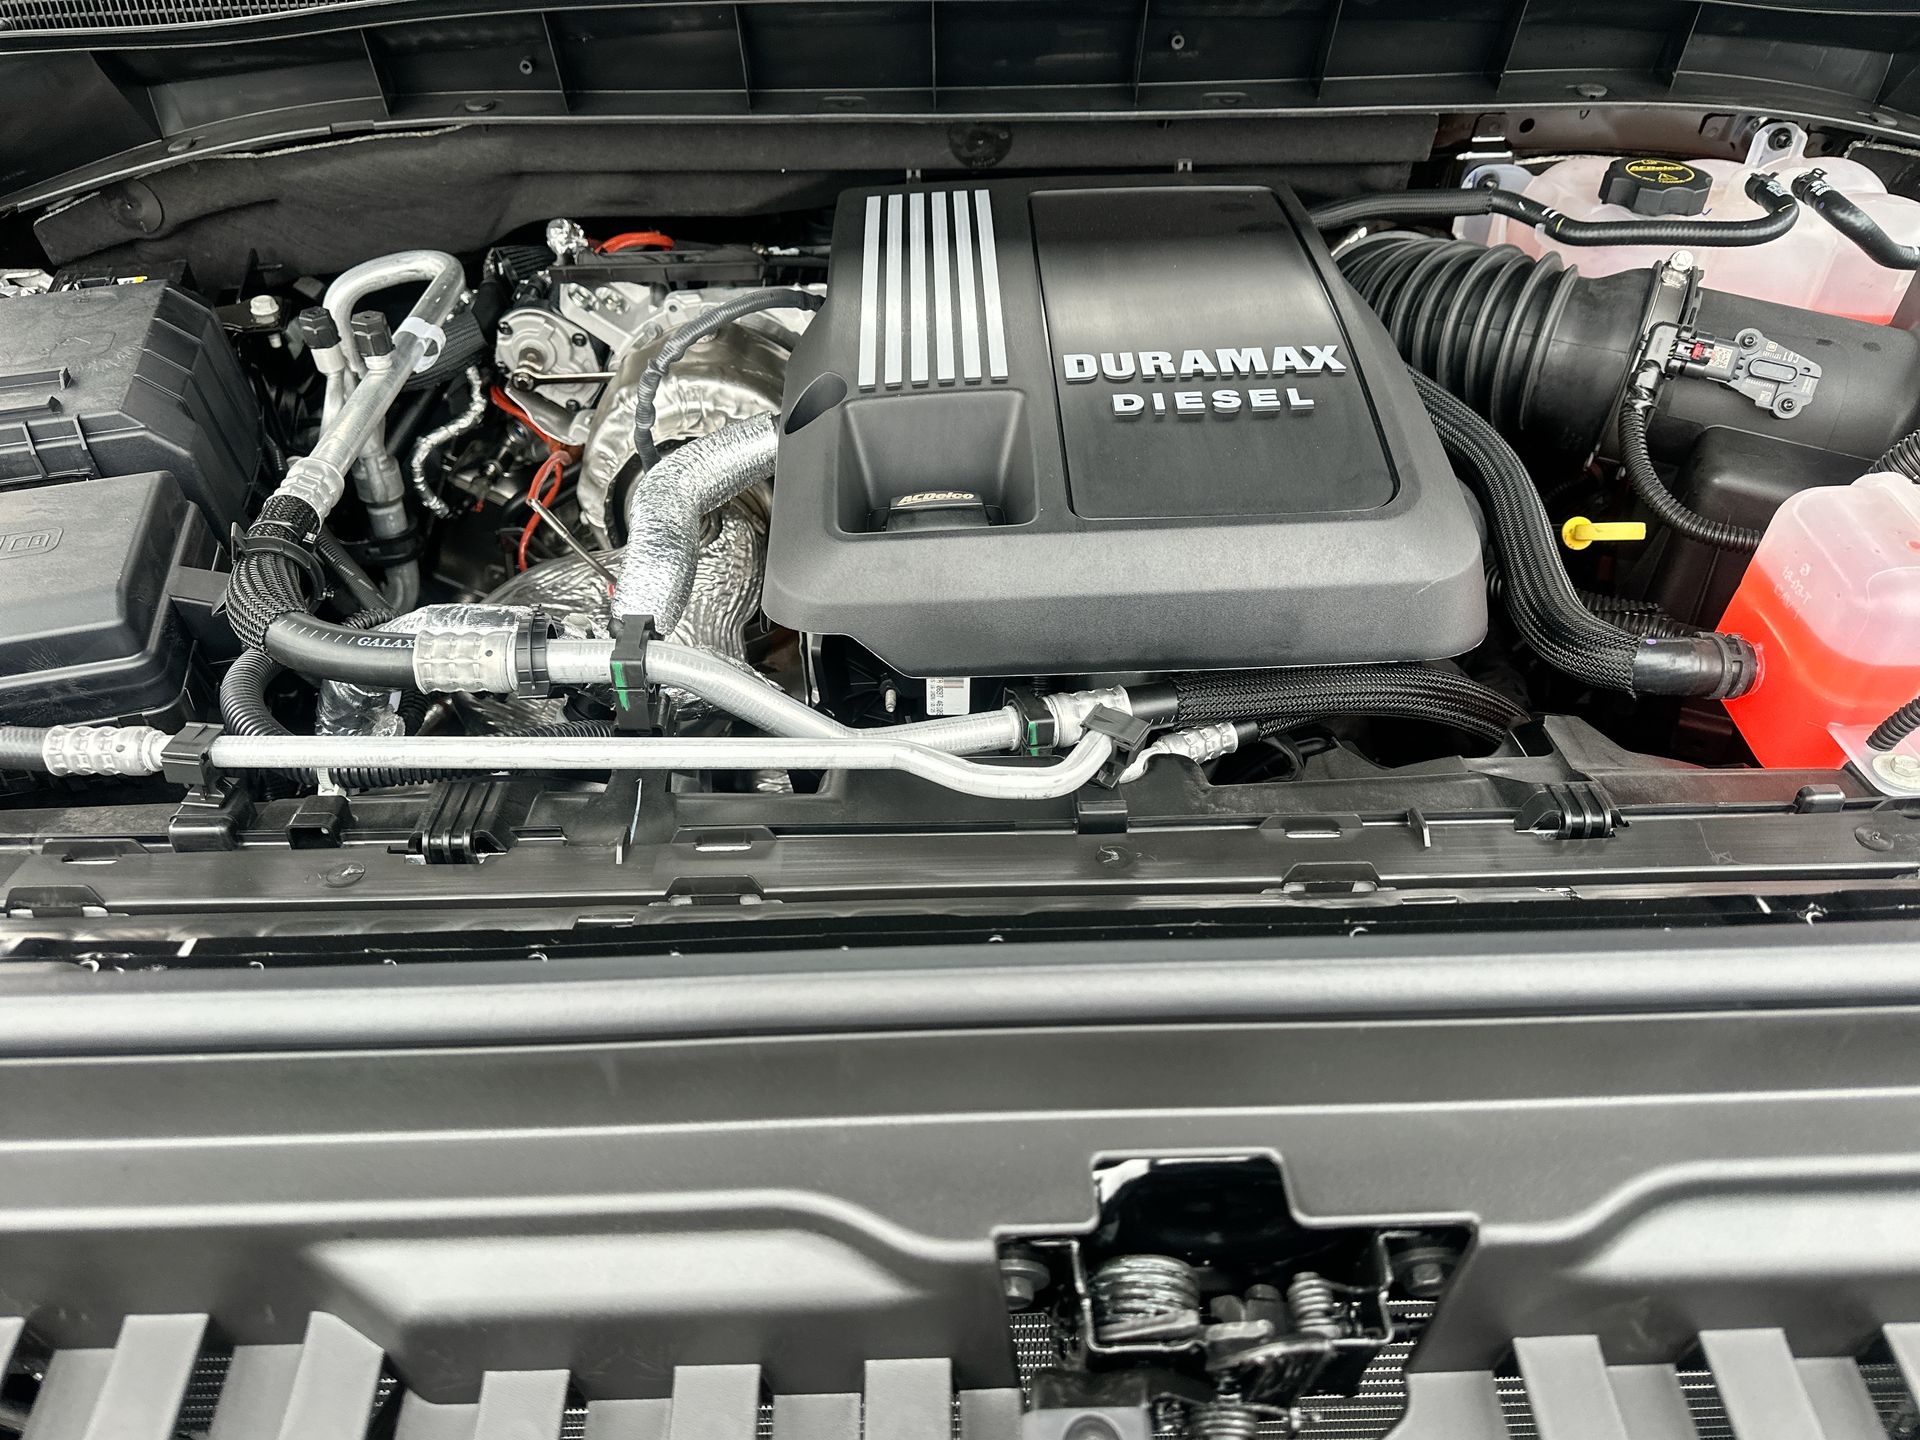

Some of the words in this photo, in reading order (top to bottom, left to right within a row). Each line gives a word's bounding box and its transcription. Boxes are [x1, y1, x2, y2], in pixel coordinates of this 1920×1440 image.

[1063, 345, 1347, 382] DURAMAX
[1112, 388, 1315, 416] DIESEL
[897, 491, 975, 506] ACDelco
